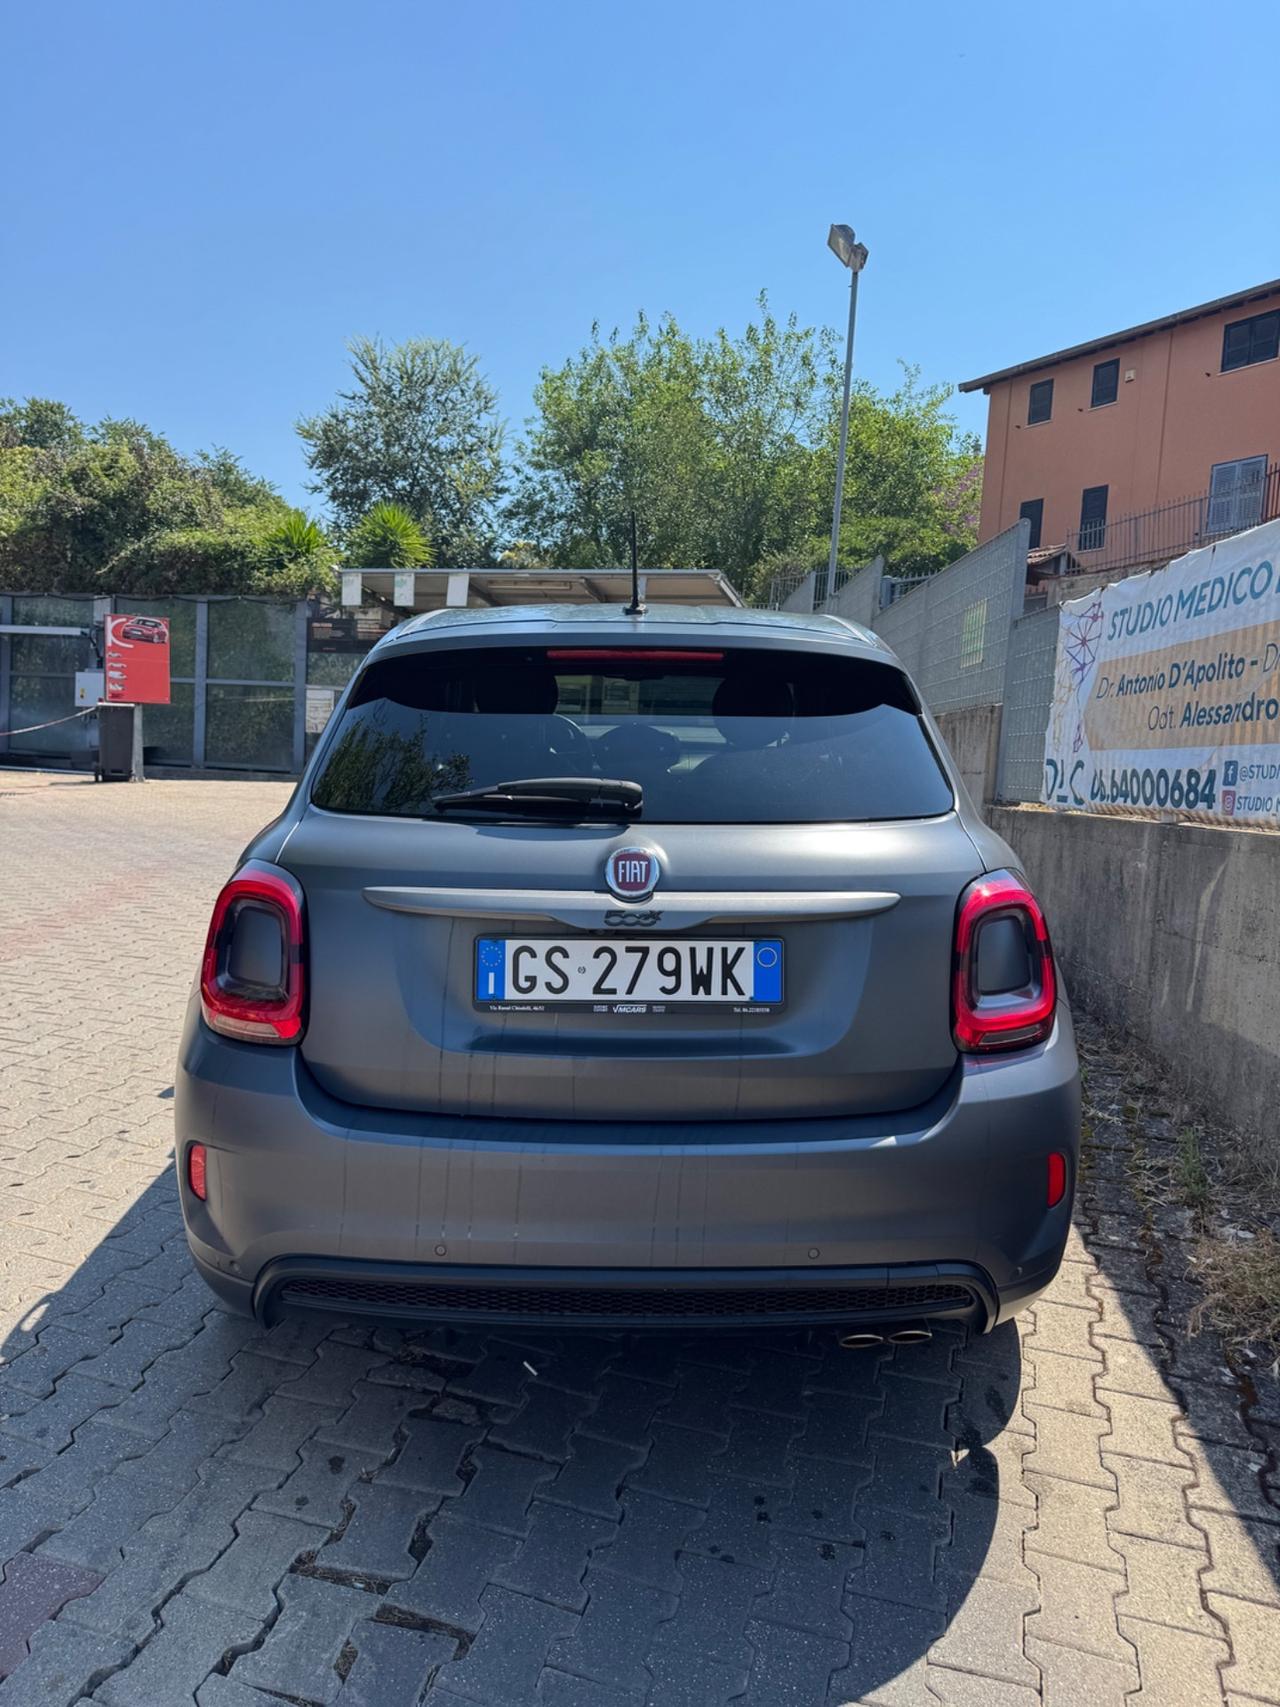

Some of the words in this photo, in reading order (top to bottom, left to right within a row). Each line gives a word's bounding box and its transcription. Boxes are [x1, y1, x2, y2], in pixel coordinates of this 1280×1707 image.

[1107, 593, 1173, 641] STUDIO
[1173, 560, 1273, 622] MEDICO
[1096, 676, 1114, 699] Dr.
[1116, 667, 1165, 697] Antonio
[1168, 652, 1245, 691] D'Apolito
[1180, 692, 1279, 729] Alessandro
[617, 860, 649, 883] FIAT
[512, 945, 570, 996] GS
[592, 945, 746, 996] 279WK
